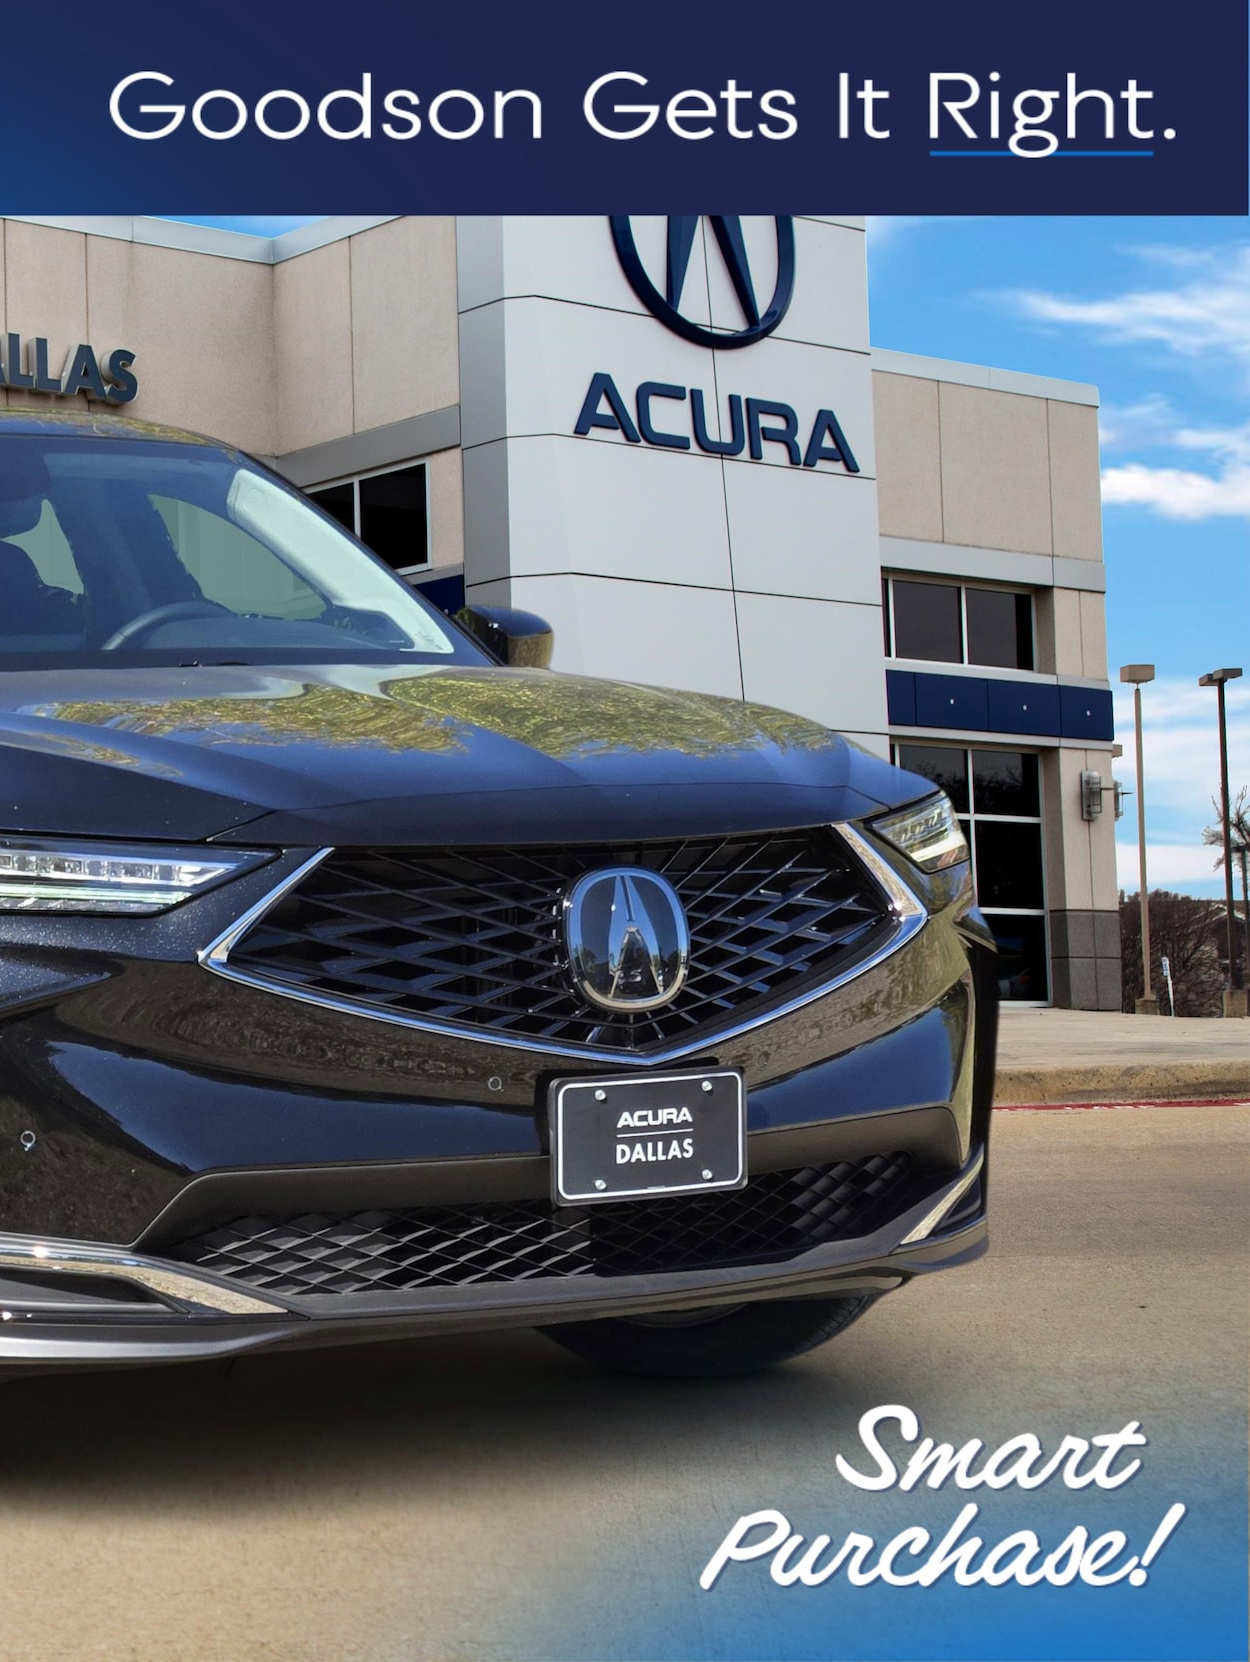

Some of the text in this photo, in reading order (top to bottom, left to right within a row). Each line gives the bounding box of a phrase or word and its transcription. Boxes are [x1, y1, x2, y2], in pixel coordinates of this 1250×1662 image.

[573, 372, 860, 474] ACURA
[616, 1106, 693, 1128] ACURA
[615, 1138, 694, 1164] DALLAS
